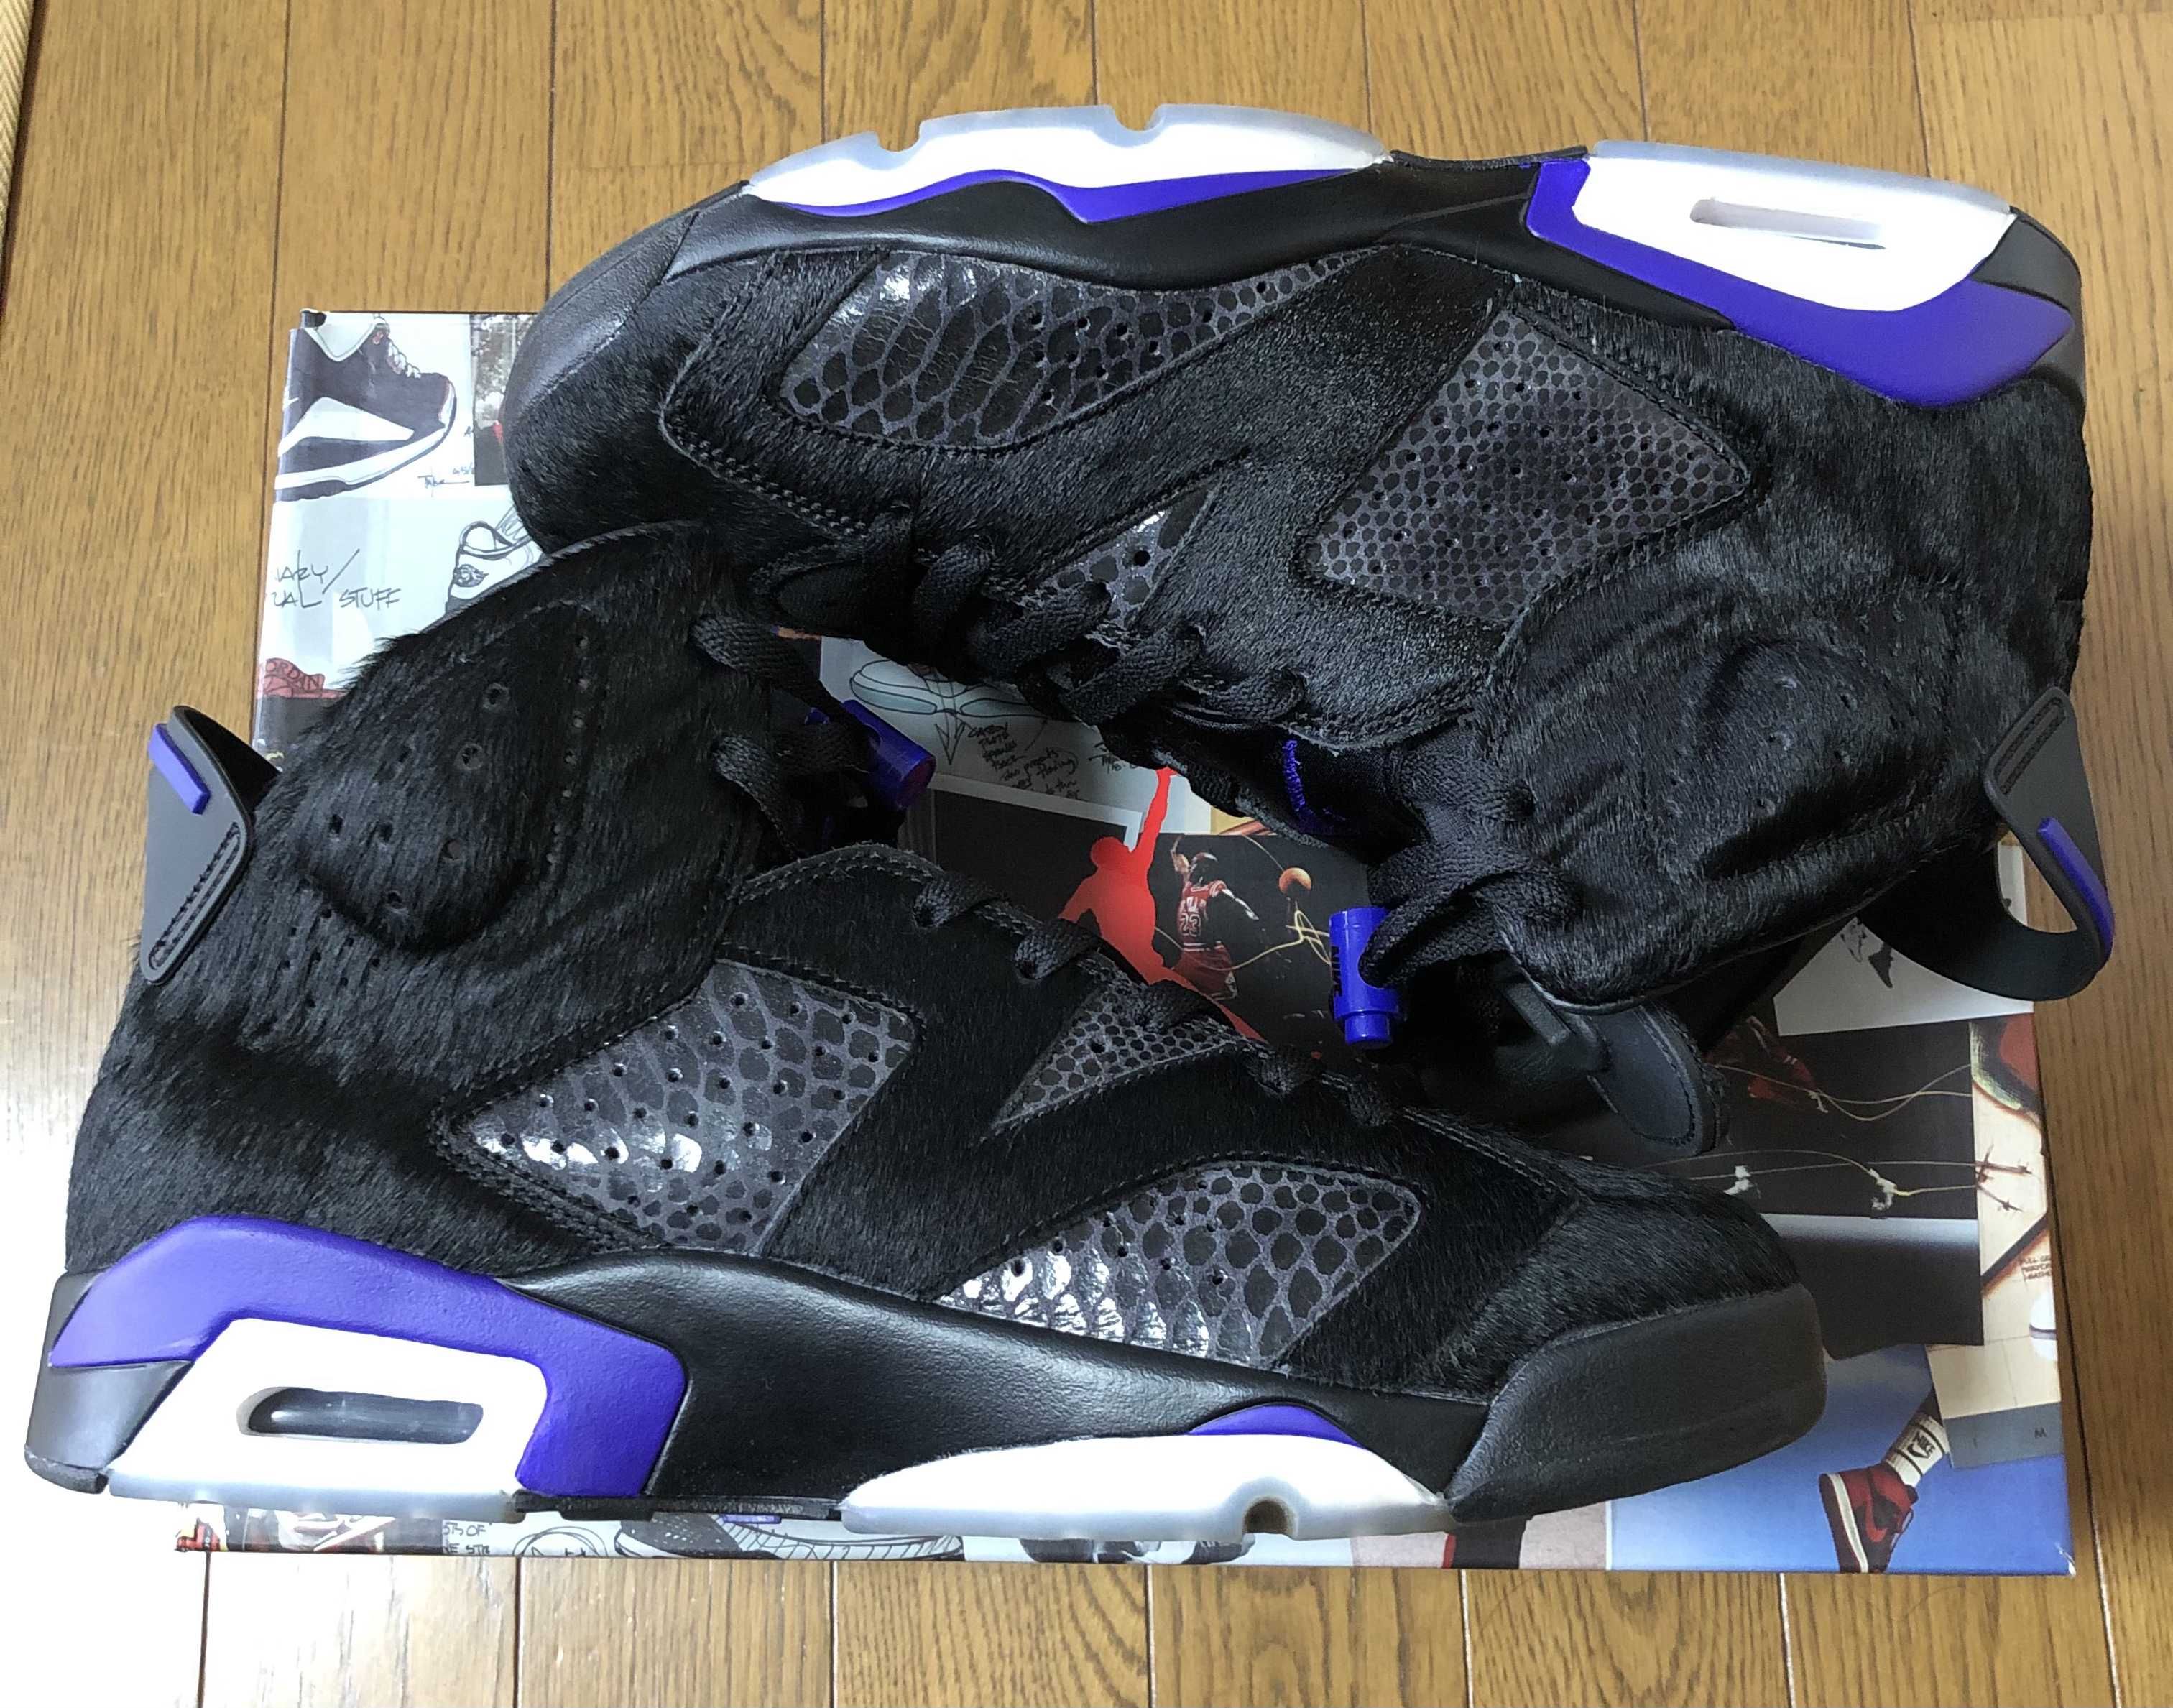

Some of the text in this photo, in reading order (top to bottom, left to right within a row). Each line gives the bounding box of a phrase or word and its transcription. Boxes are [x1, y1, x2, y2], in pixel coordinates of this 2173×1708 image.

[338, 587, 402, 611] STUFF
[1178, 912, 1201, 937] 23
[1912, 1431, 1935, 1454] NIKE
[466, 1524, 486, 1537] OF
